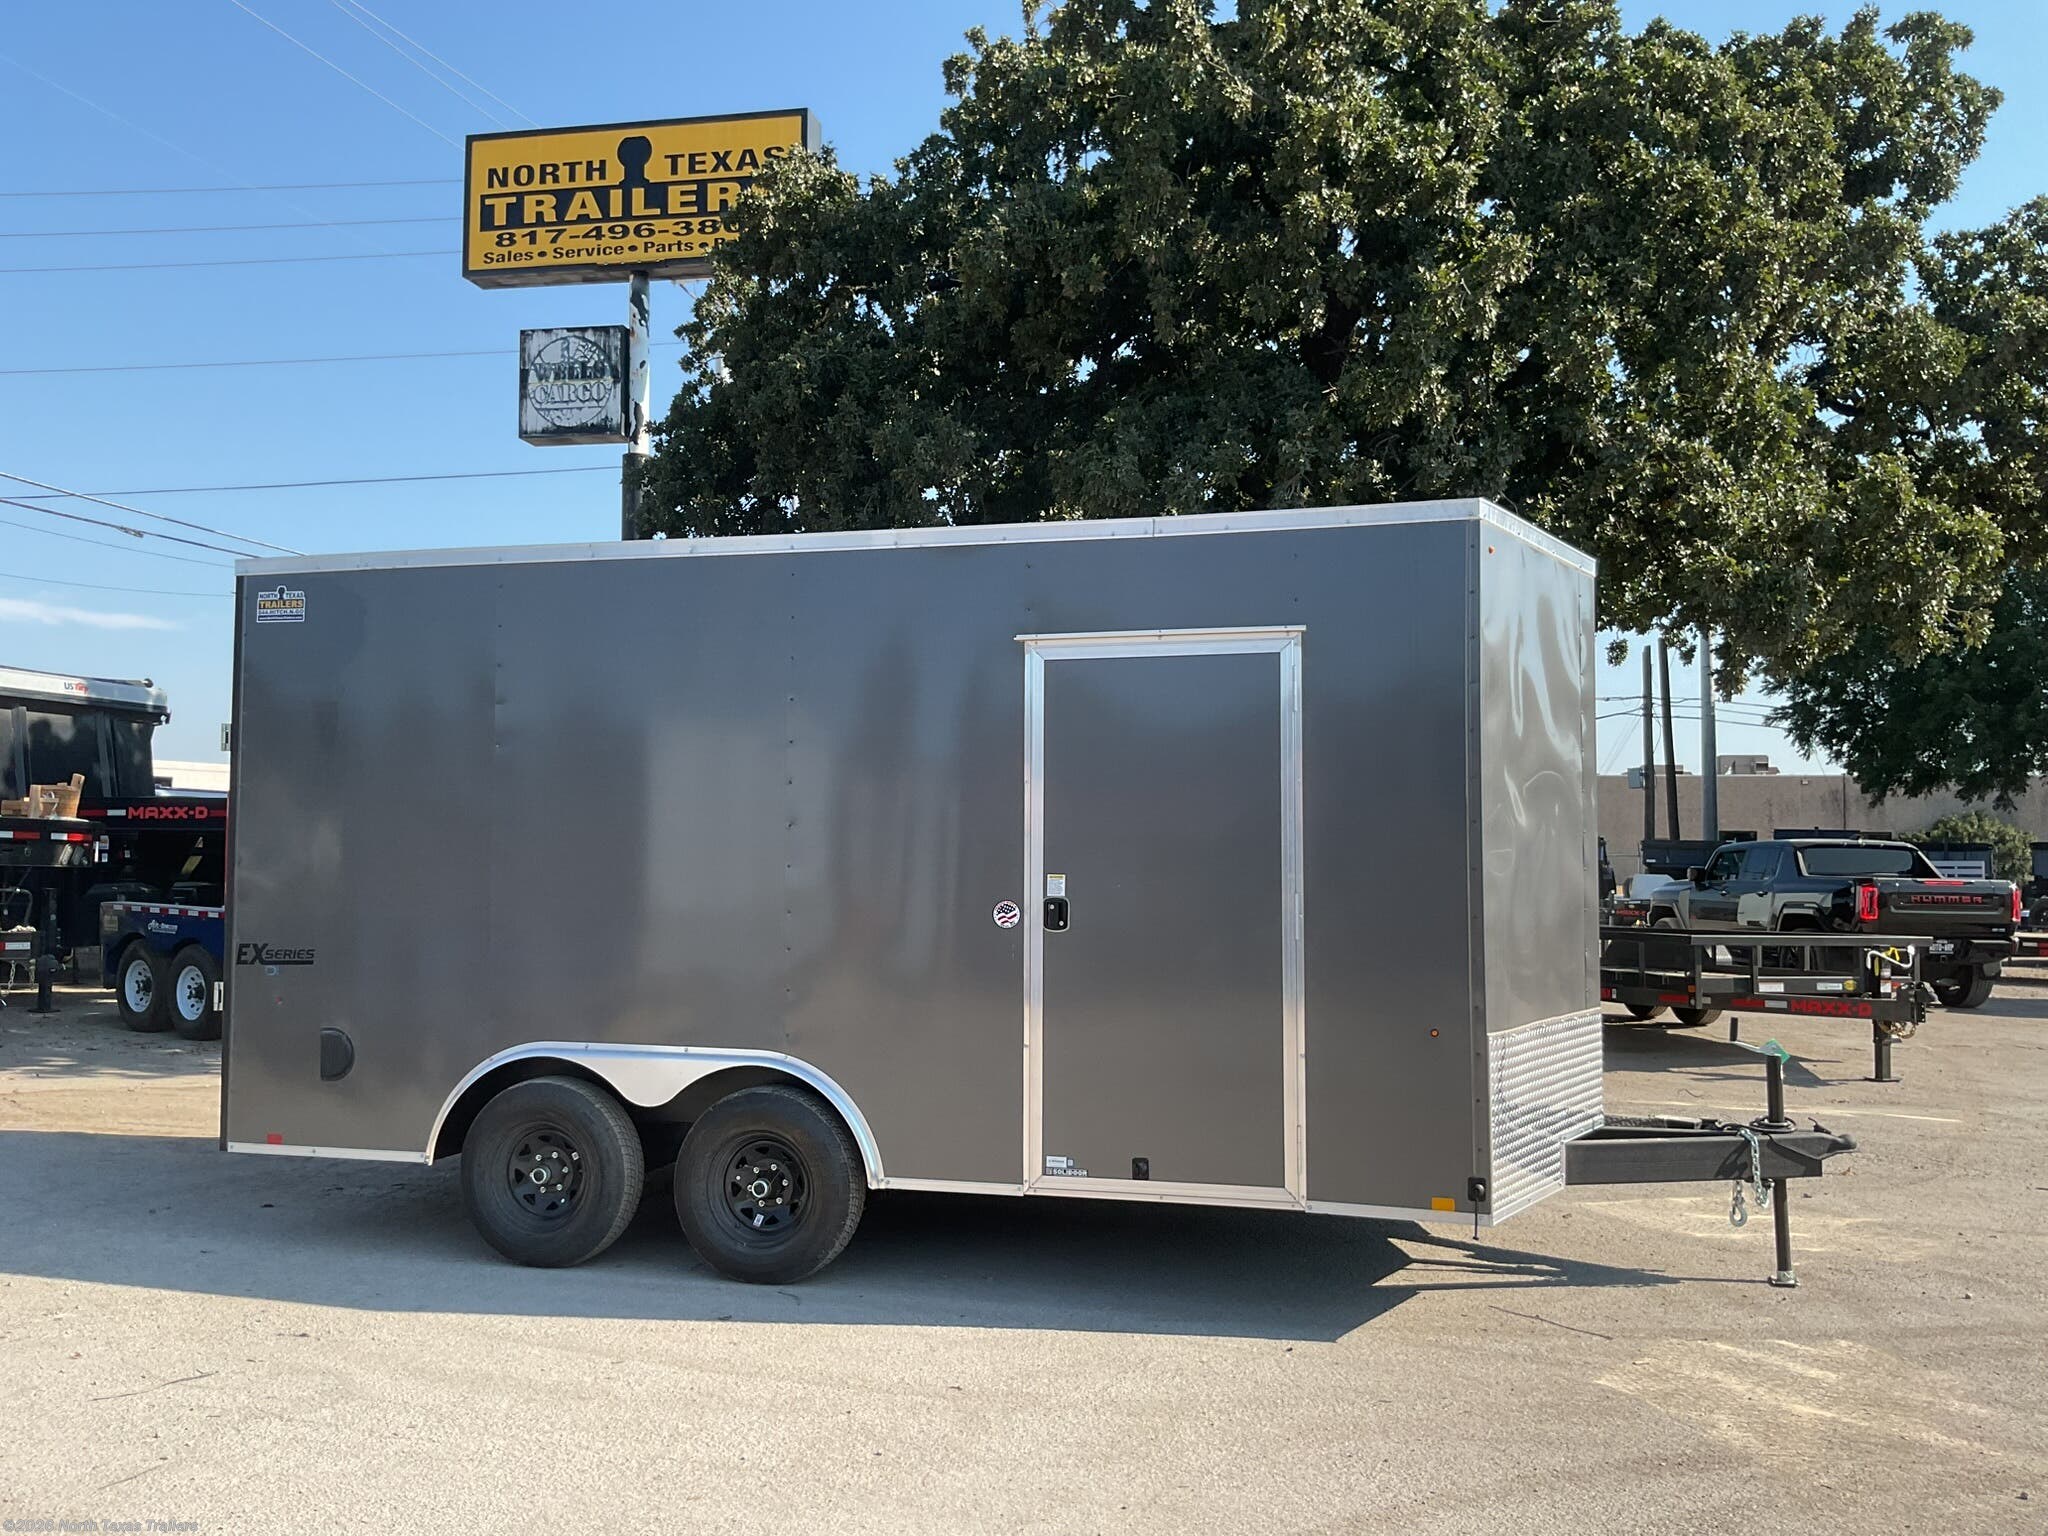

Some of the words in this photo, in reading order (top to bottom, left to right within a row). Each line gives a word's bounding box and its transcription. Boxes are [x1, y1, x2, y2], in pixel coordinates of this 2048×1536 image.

[487, 158, 607, 189] NORTH
[664, 146, 785, 177] TEXAS
[484, 181, 768, 228] TRAILER
[483, 249, 534, 265] Sales
[552, 243, 625, 260] Service
[643, 239, 694, 255] Parts
[533, 381, 607, 404] CARGO
[259, 600, 303, 609] TRAILERS
[64, 682, 74, 690] US
[127, 806, 209, 820] MAXX-D
[1911, 895, 1984, 904] HUMMER
[1791, 999, 1873, 1018] MAXX-D
